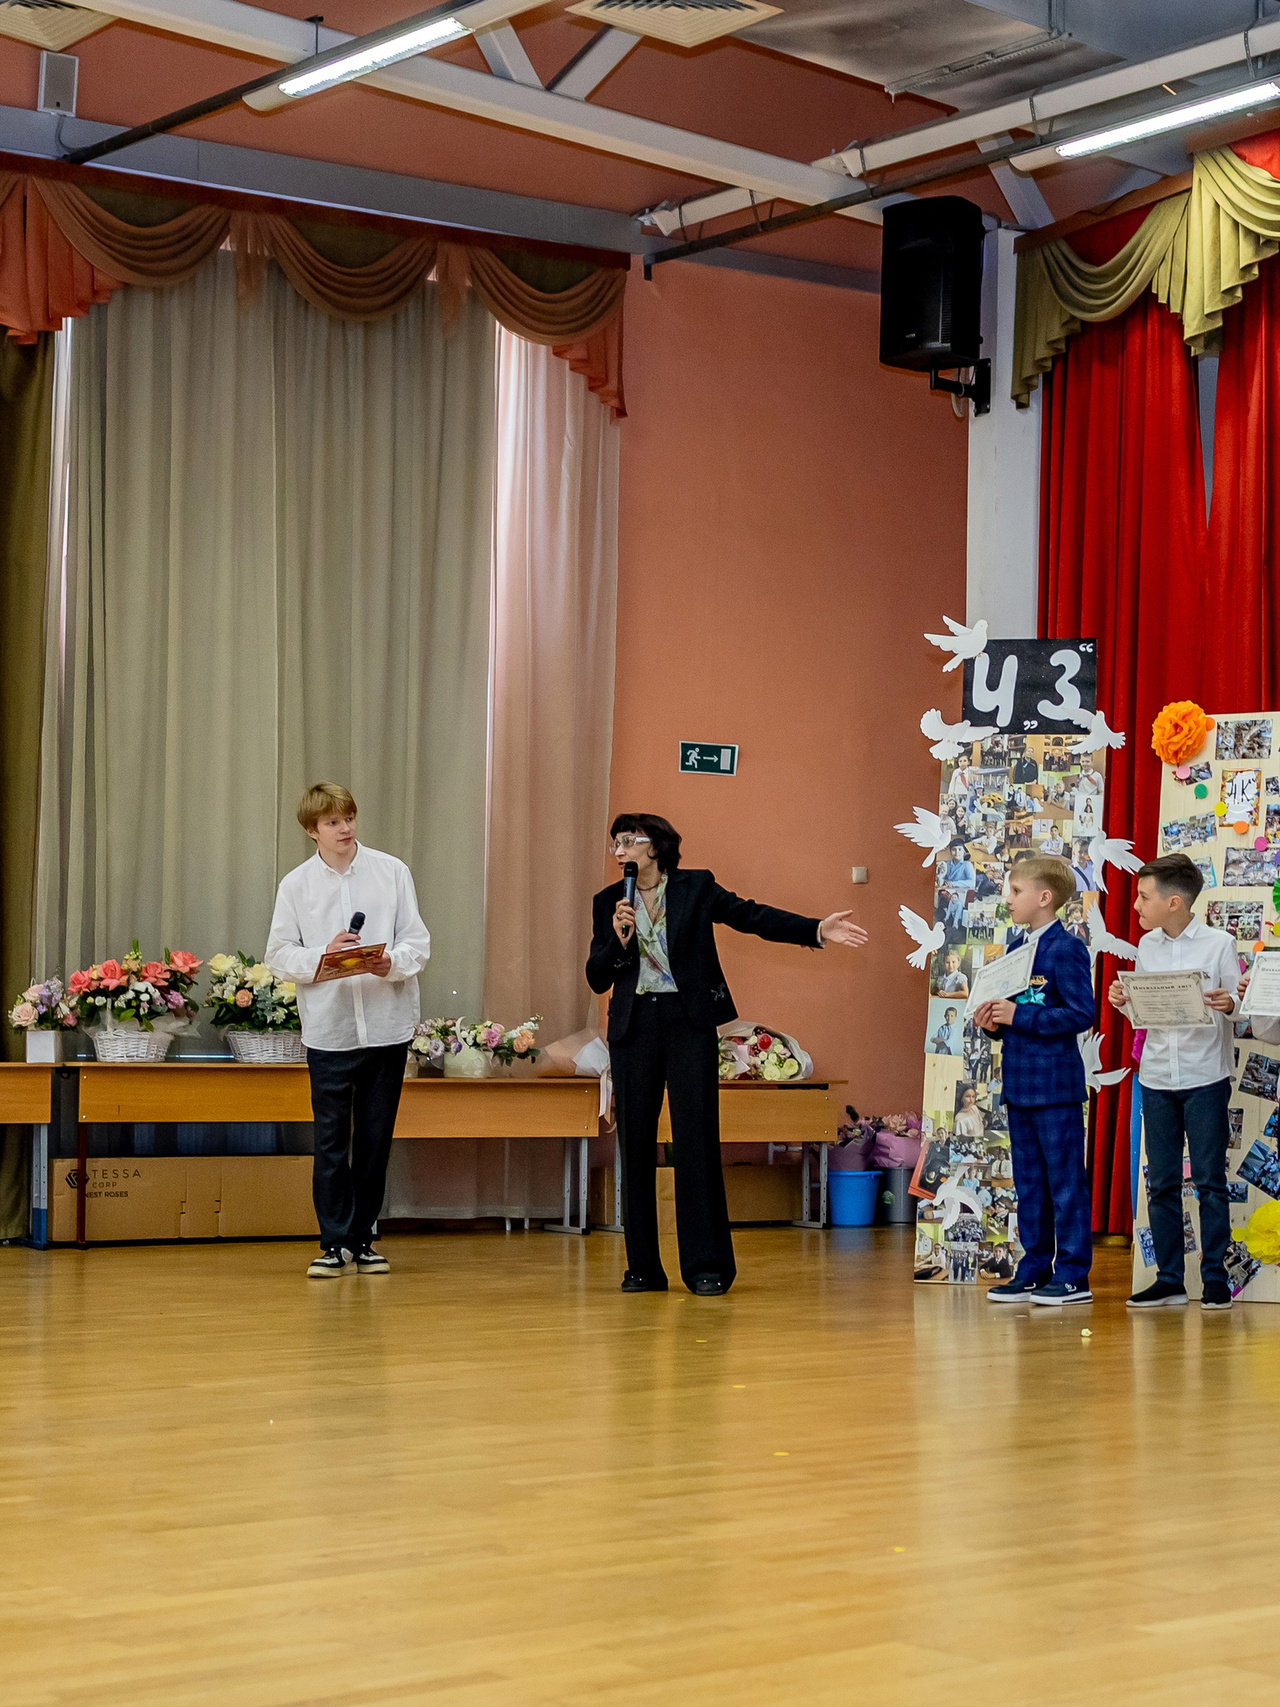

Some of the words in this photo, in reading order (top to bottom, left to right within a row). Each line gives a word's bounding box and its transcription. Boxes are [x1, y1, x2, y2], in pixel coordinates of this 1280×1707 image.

[91, 1168, 141, 1179] TESSA
[92, 1181, 118, 1189] CORP
[104, 1190, 129, 1198] ROSES
